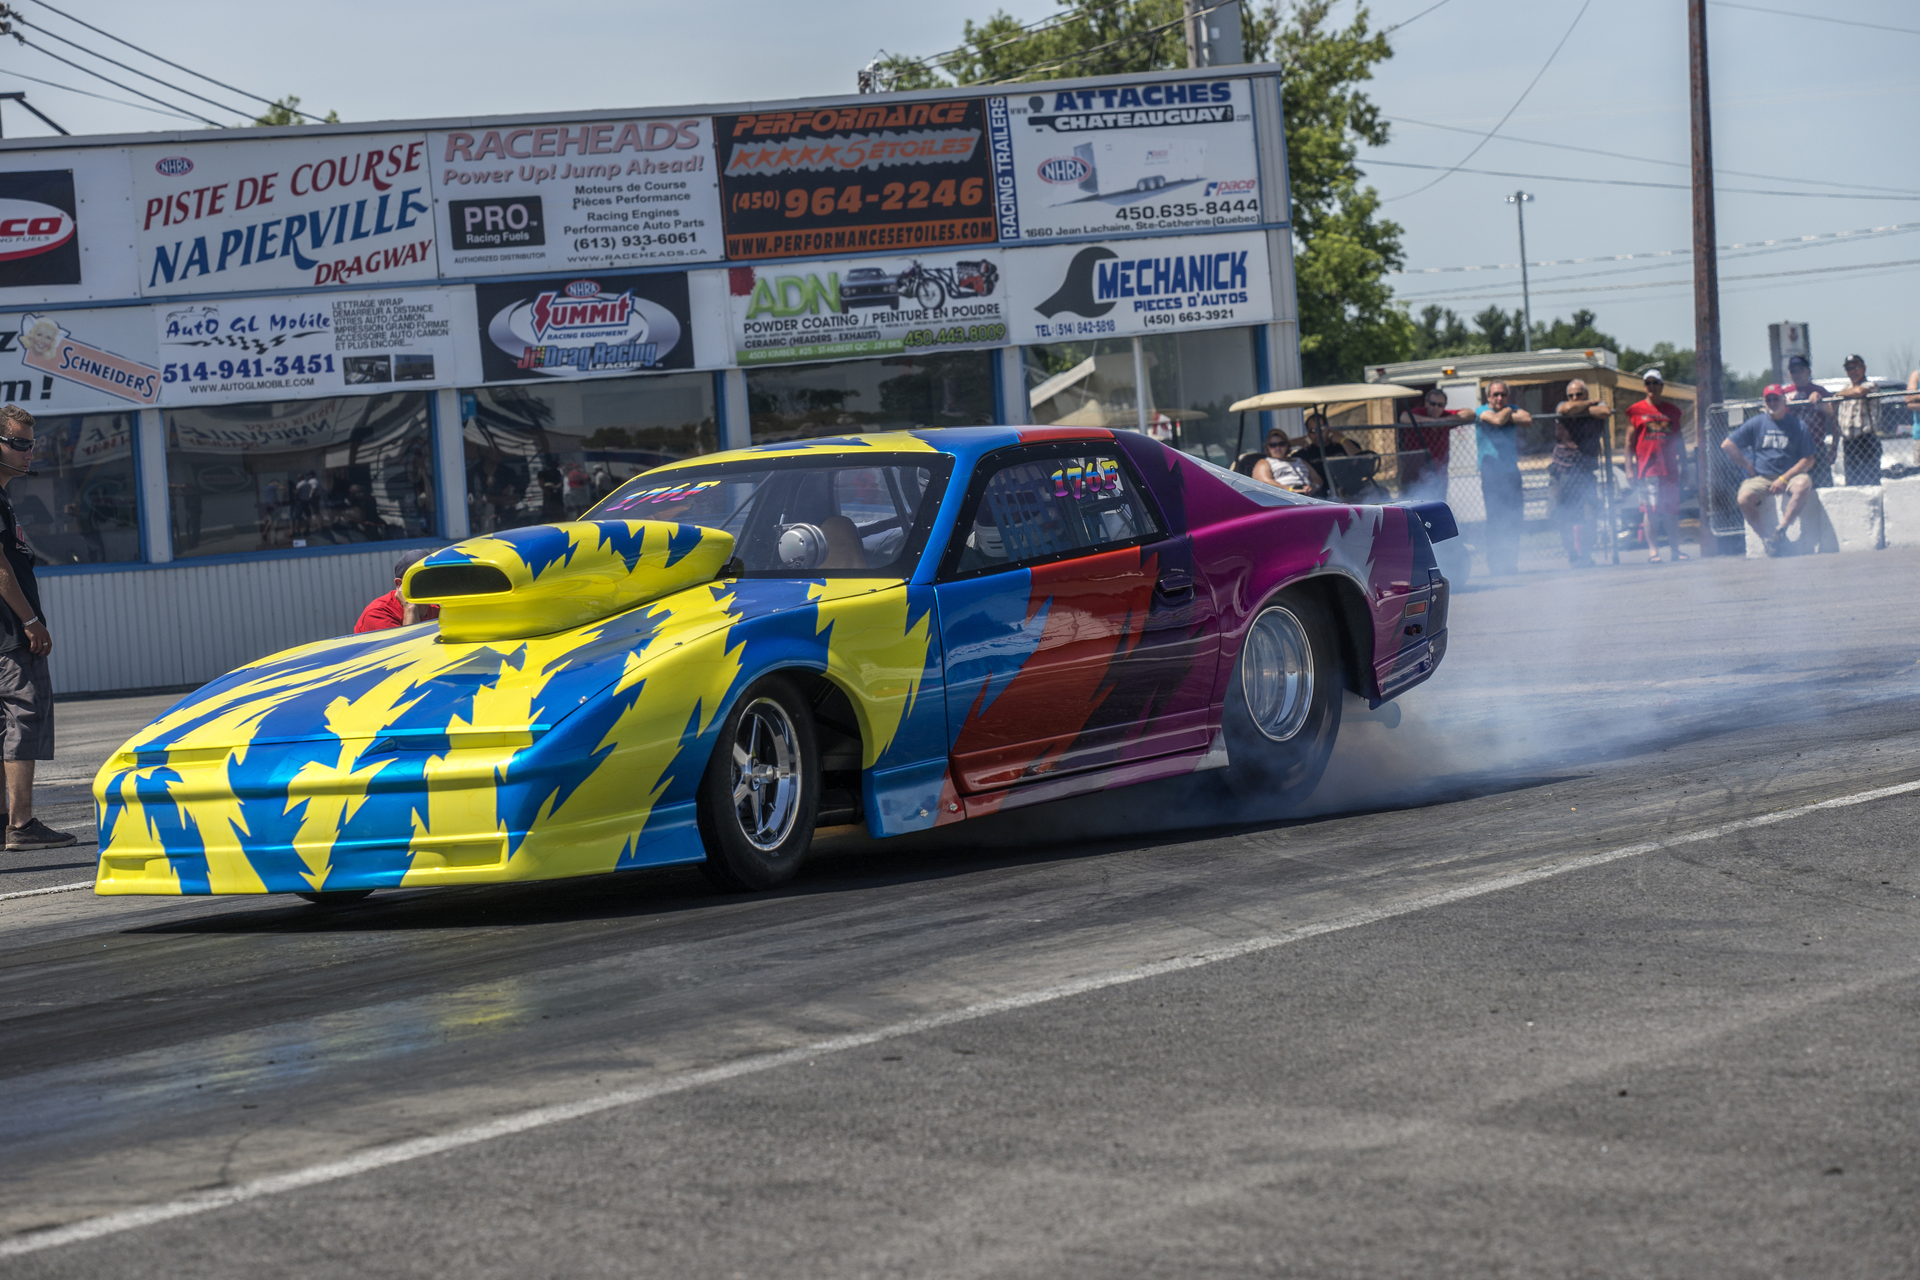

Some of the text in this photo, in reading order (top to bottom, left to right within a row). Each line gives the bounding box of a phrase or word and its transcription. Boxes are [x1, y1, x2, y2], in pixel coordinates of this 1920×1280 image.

[1053, 82, 1233, 112] ATTACHES
[732, 102, 969, 137] PERFORMANCE
[1054, 107, 1227, 131] CHATEAUGUAY
[444, 120, 700, 162] RACEHEADS
[159, 159, 190, 174] NHRA
[442, 155, 705, 186] Power Up! Jump Ahead!
[991, 97, 1018, 239] RACING TRAILERS
[1045, 159, 1084, 181] NHRA
[143, 141, 425, 232] PISTE DE COURSE
[575, 181, 687, 195] Moteurs de Course
[615, 192, 691, 205] Performance
[732, 177, 984, 219] (450) 964-2246
[463, 203, 529, 233] PRO
[587, 208, 680, 222] Racing Engines
[1115, 199, 1259, 221] 450.635-8444
[564, 218, 705, 235] Performance Auto Parts
[1024, 228, 1053, 238] 1660
[1055, 226, 1082, 236] Jean
[1136, 219, 1212, 231] Ste-Catherine
[15, 235, 50, 243] FUELS
[148, 187, 429, 289] NAPIERVILLE
[466, 231, 530, 245] Racing Fuels
[573, 231, 697, 252] (613) 933-6061
[728, 221, 993, 257] WWW.PERFORMANCE5ETOILES.COM
[314, 239, 433, 286] DRAGWAY
[454, 251, 546, 264] AUTHORIZED DISTRIBUTOR
[1098, 250, 1249, 300] MECHANICK
[569, 283, 598, 297] NHRA
[745, 272, 842, 320] ADN
[332, 297, 404, 310] LETTRAGE WRAP
[385, 307, 392, 315] A
[393, 304, 434, 314] DISTANCE
[1134, 291, 1249, 313] PIECES D'AUTOS
[229, 315, 260, 334] GL
[270, 312, 331, 331] Mobile
[334, 316, 363, 326] VITRES
[334, 320, 449, 334] IMPRESSION GRAND FORMAT
[743, 319, 798, 334] POWDER
[801, 314, 859, 330] COATING
[872, 308, 929, 324] PEINTURE
[933, 307, 948, 319] EN
[952, 303, 1000, 317] POUDRE
[1077, 319, 1116, 335] 842-5818
[1143, 309, 1235, 327] (450) 663-3921
[335, 332, 387, 343] ACCESSOIRE
[580, 329, 629, 339] EQUIPMENT
[744, 337, 787, 350] CERAMIC
[789, 334, 833, 347] (HEADERS
[839, 330, 881, 342] EXHAUST)
[904, 323, 1006, 347] 450.443.8009
[335, 342, 346, 351] ET
[347, 341, 369, 350] PLUS
[543, 345, 593, 371] Drag
[593, 342, 658, 366] Racing
[59, 346, 156, 398] SCHNEIDERS
[162, 353, 335, 384] 514-941-3451
[588, 361, 641, 370] LEAGUE
[189, 378, 315, 394] WWW.AUTOGLMOBILE.COM
[1051, 460, 1119, 500] 176F
[605, 480, 722, 512] 176F
